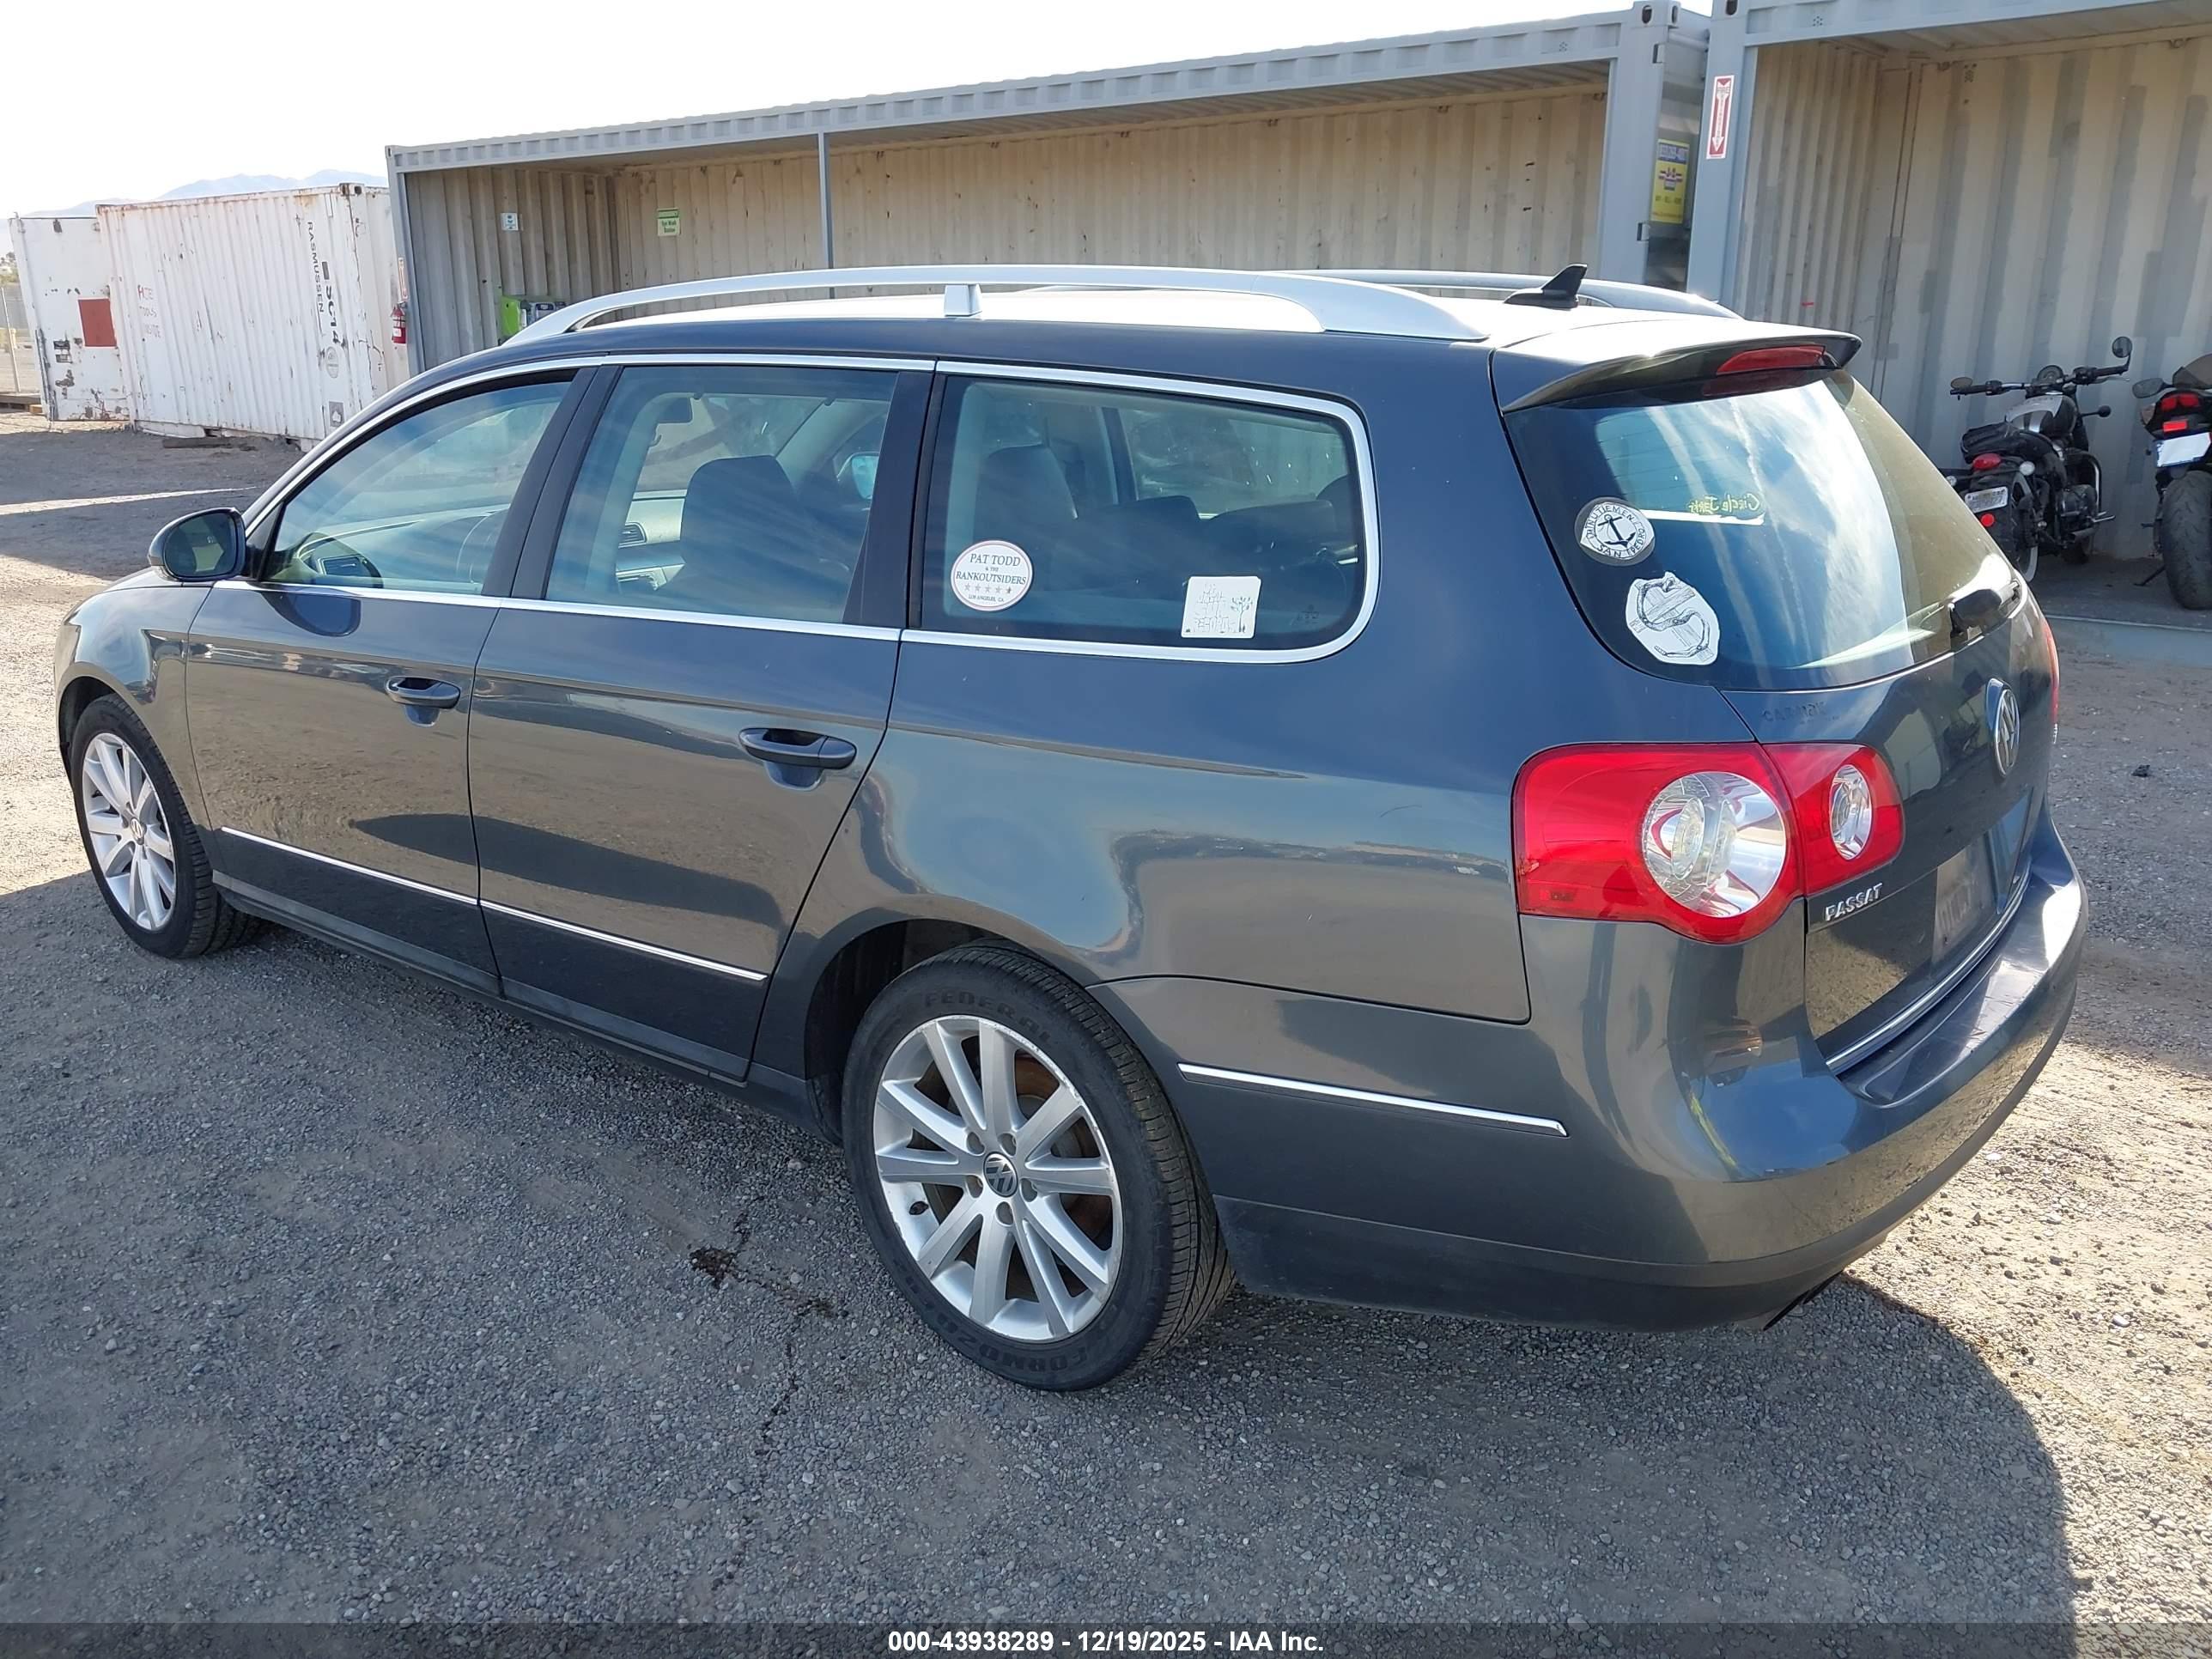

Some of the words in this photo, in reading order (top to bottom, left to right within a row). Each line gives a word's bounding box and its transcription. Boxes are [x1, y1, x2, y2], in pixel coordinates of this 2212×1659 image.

[307, 222, 325, 313] RASMUSSEN
[1597, 544, 1622, 557] SAN
[969, 553, 990, 564] PAT
[991, 555, 1021, 567] TODD
[956, 571, 1027, 585] RANKOUTSIDERS
[1826, 882, 1883, 921] PASSAT
